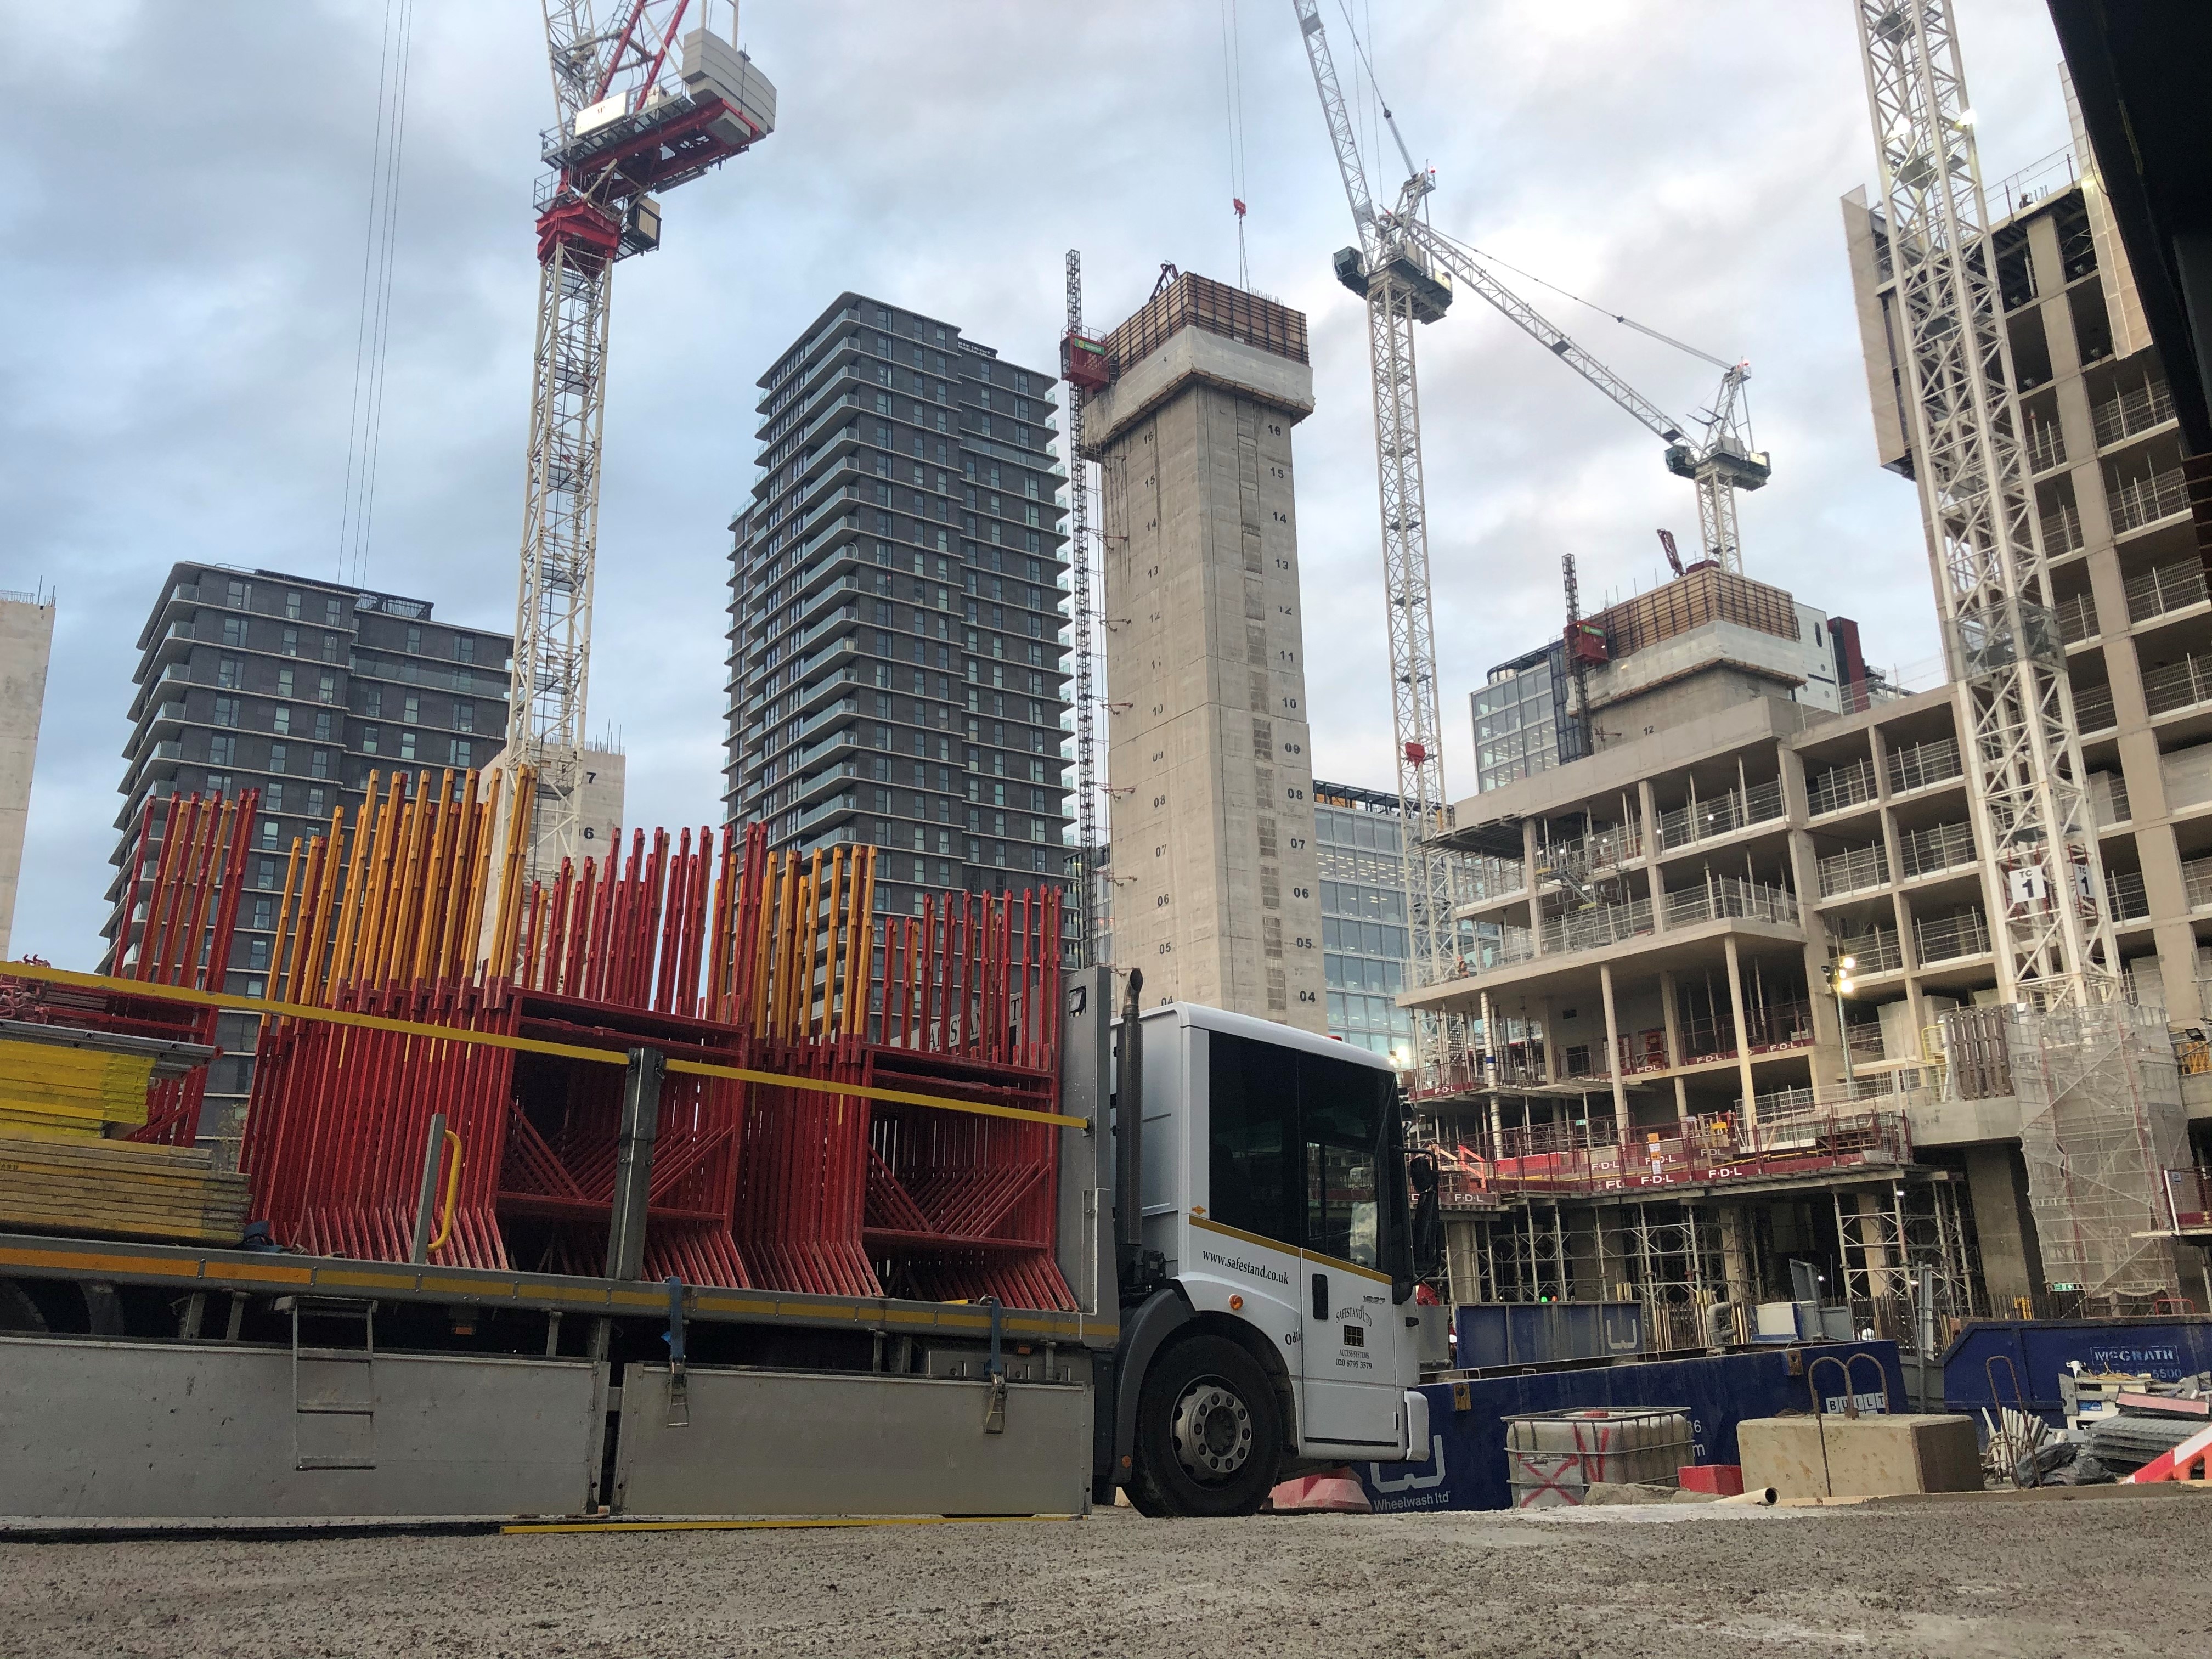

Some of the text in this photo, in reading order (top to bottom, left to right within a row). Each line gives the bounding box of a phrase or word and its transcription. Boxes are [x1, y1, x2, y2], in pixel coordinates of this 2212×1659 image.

[1270, 467, 1284, 479] 15
[1145, 474, 1155, 488] 15
[1273, 511, 1287, 524] 14
[1146, 517, 1157, 532] 14
[1275, 558, 1289, 570] 13
[1148, 565, 1158, 578] 13
[1278, 605, 1292, 616] 12
[1149, 611, 1160, 624] 12
[1280, 650, 1294, 663] 11
[1153, 703, 1163, 716] 10
[1282, 697, 1296, 709] 10
[1643, 725, 1655, 736] 12
[1285, 742, 1300, 754] 09
[1288, 788, 1304, 800] 08
[1154, 794, 1166, 808] 08
[1155, 843, 1167, 857] 07
[1290, 838, 1306, 850] 07
[2019, 870, 2033, 878] TC
[2078, 866, 2087, 874] TC
[2021, 878, 2034, 898] 1
[2081, 876, 2090, 896] 1
[1294, 887, 1310, 899] 06
[1158, 893, 1170, 907] 06
[1159, 941, 1171, 955] 05
[1296, 937, 1312, 949] 05
[1161, 995, 1173, 1006] 04
[1300, 991, 1316, 1003] 04
[1202, 1250, 1289, 1285] www.safestand.co.uk
[1335, 1307, 1362, 1323] SAFESTAND
[1339, 1349, 1369, 1359] ACCESS SYSTEMS
[1335, 1358, 1373, 1370] 020 8795 3579
[1830, 1395, 1884, 1410] BUILT
[1374, 1491, 1449, 1512] Wheelwash ltd
